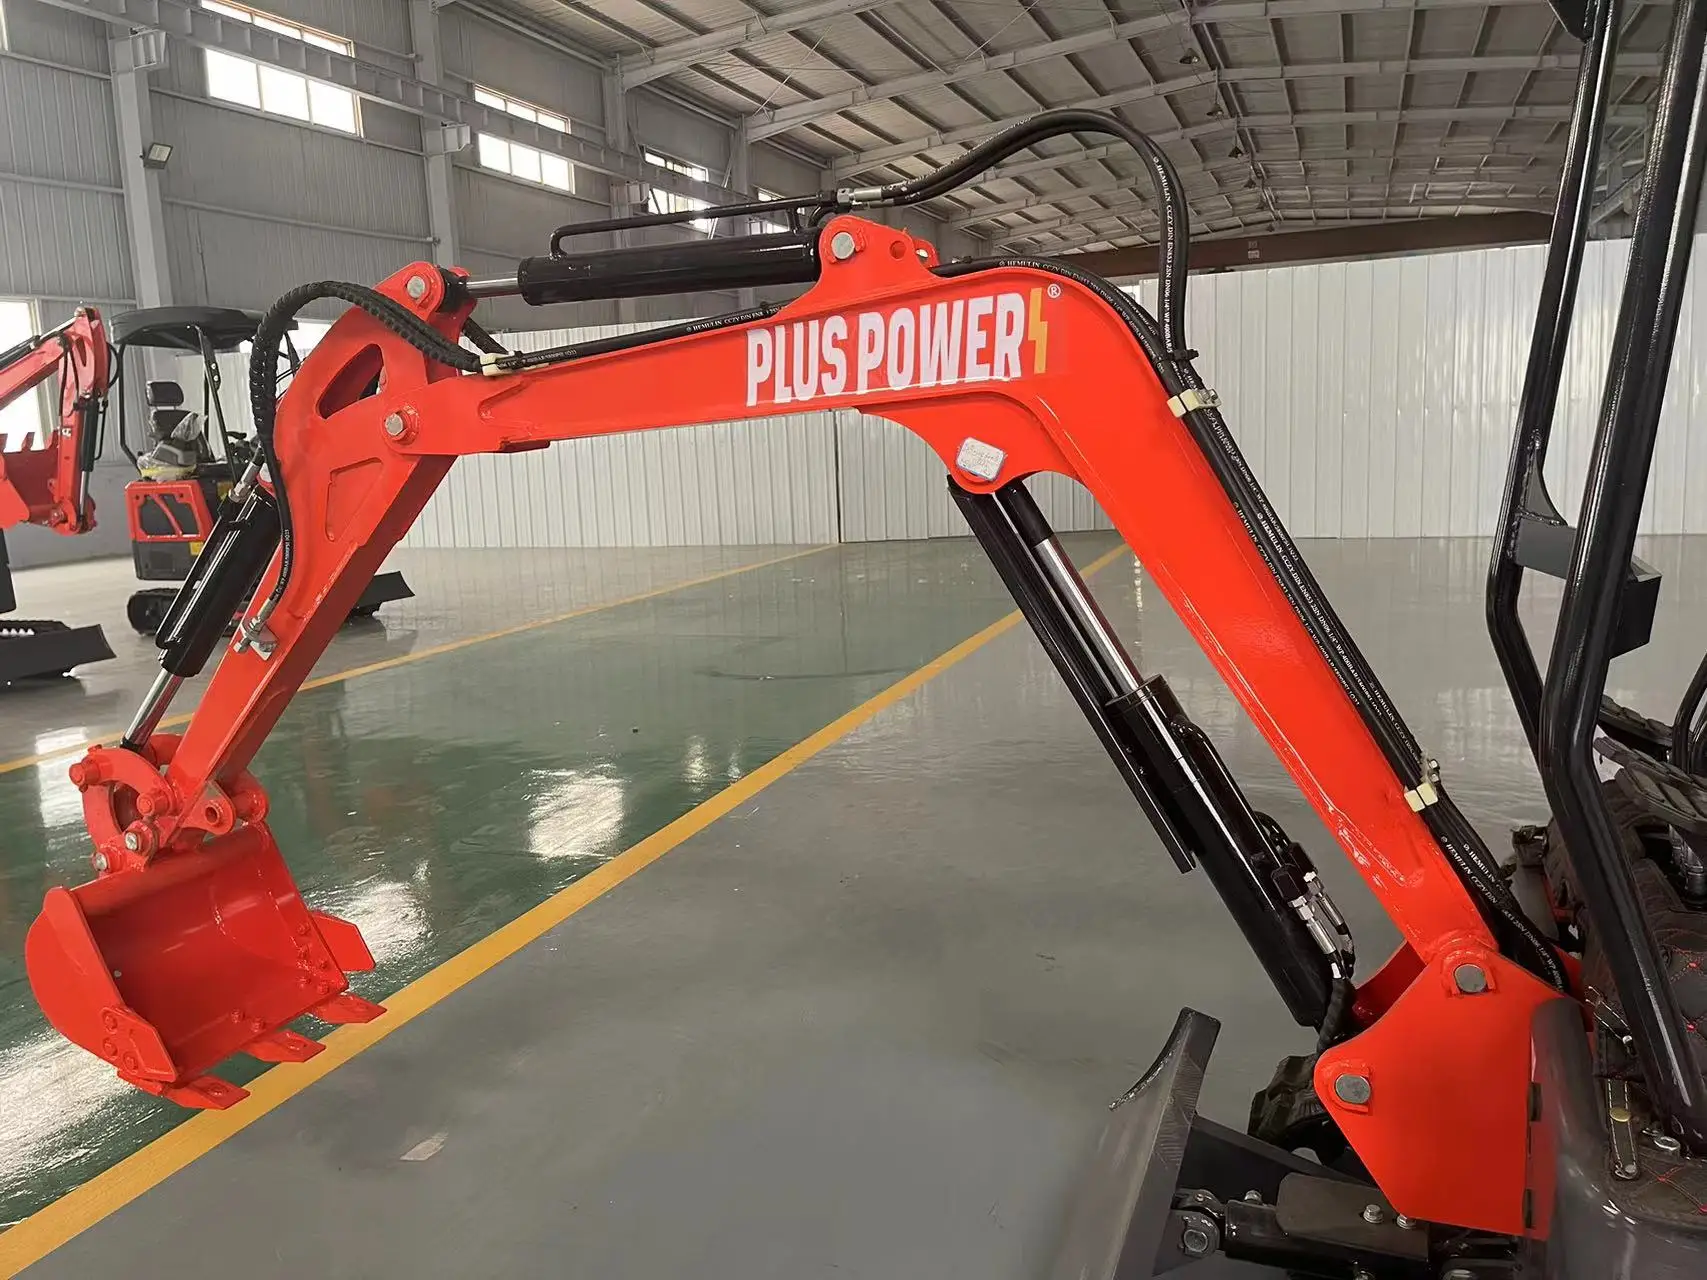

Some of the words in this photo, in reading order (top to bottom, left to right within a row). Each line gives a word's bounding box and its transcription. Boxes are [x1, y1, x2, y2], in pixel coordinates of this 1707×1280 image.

[1158, 165, 1171, 202] HEMULIN
[746, 316, 850, 408] PLUS
[857, 291, 1025, 396] POWER
[1164, 311, 1170, 322] WP
[1261, 520, 1283, 553] HEMULIN
[1281, 554, 1294, 573] CCZY
[1291, 572, 1302, 585] DIN
[1299, 585, 1313, 604] EN853
[1317, 615, 1331, 633] DN06
[1335, 643, 1345, 655] WP
